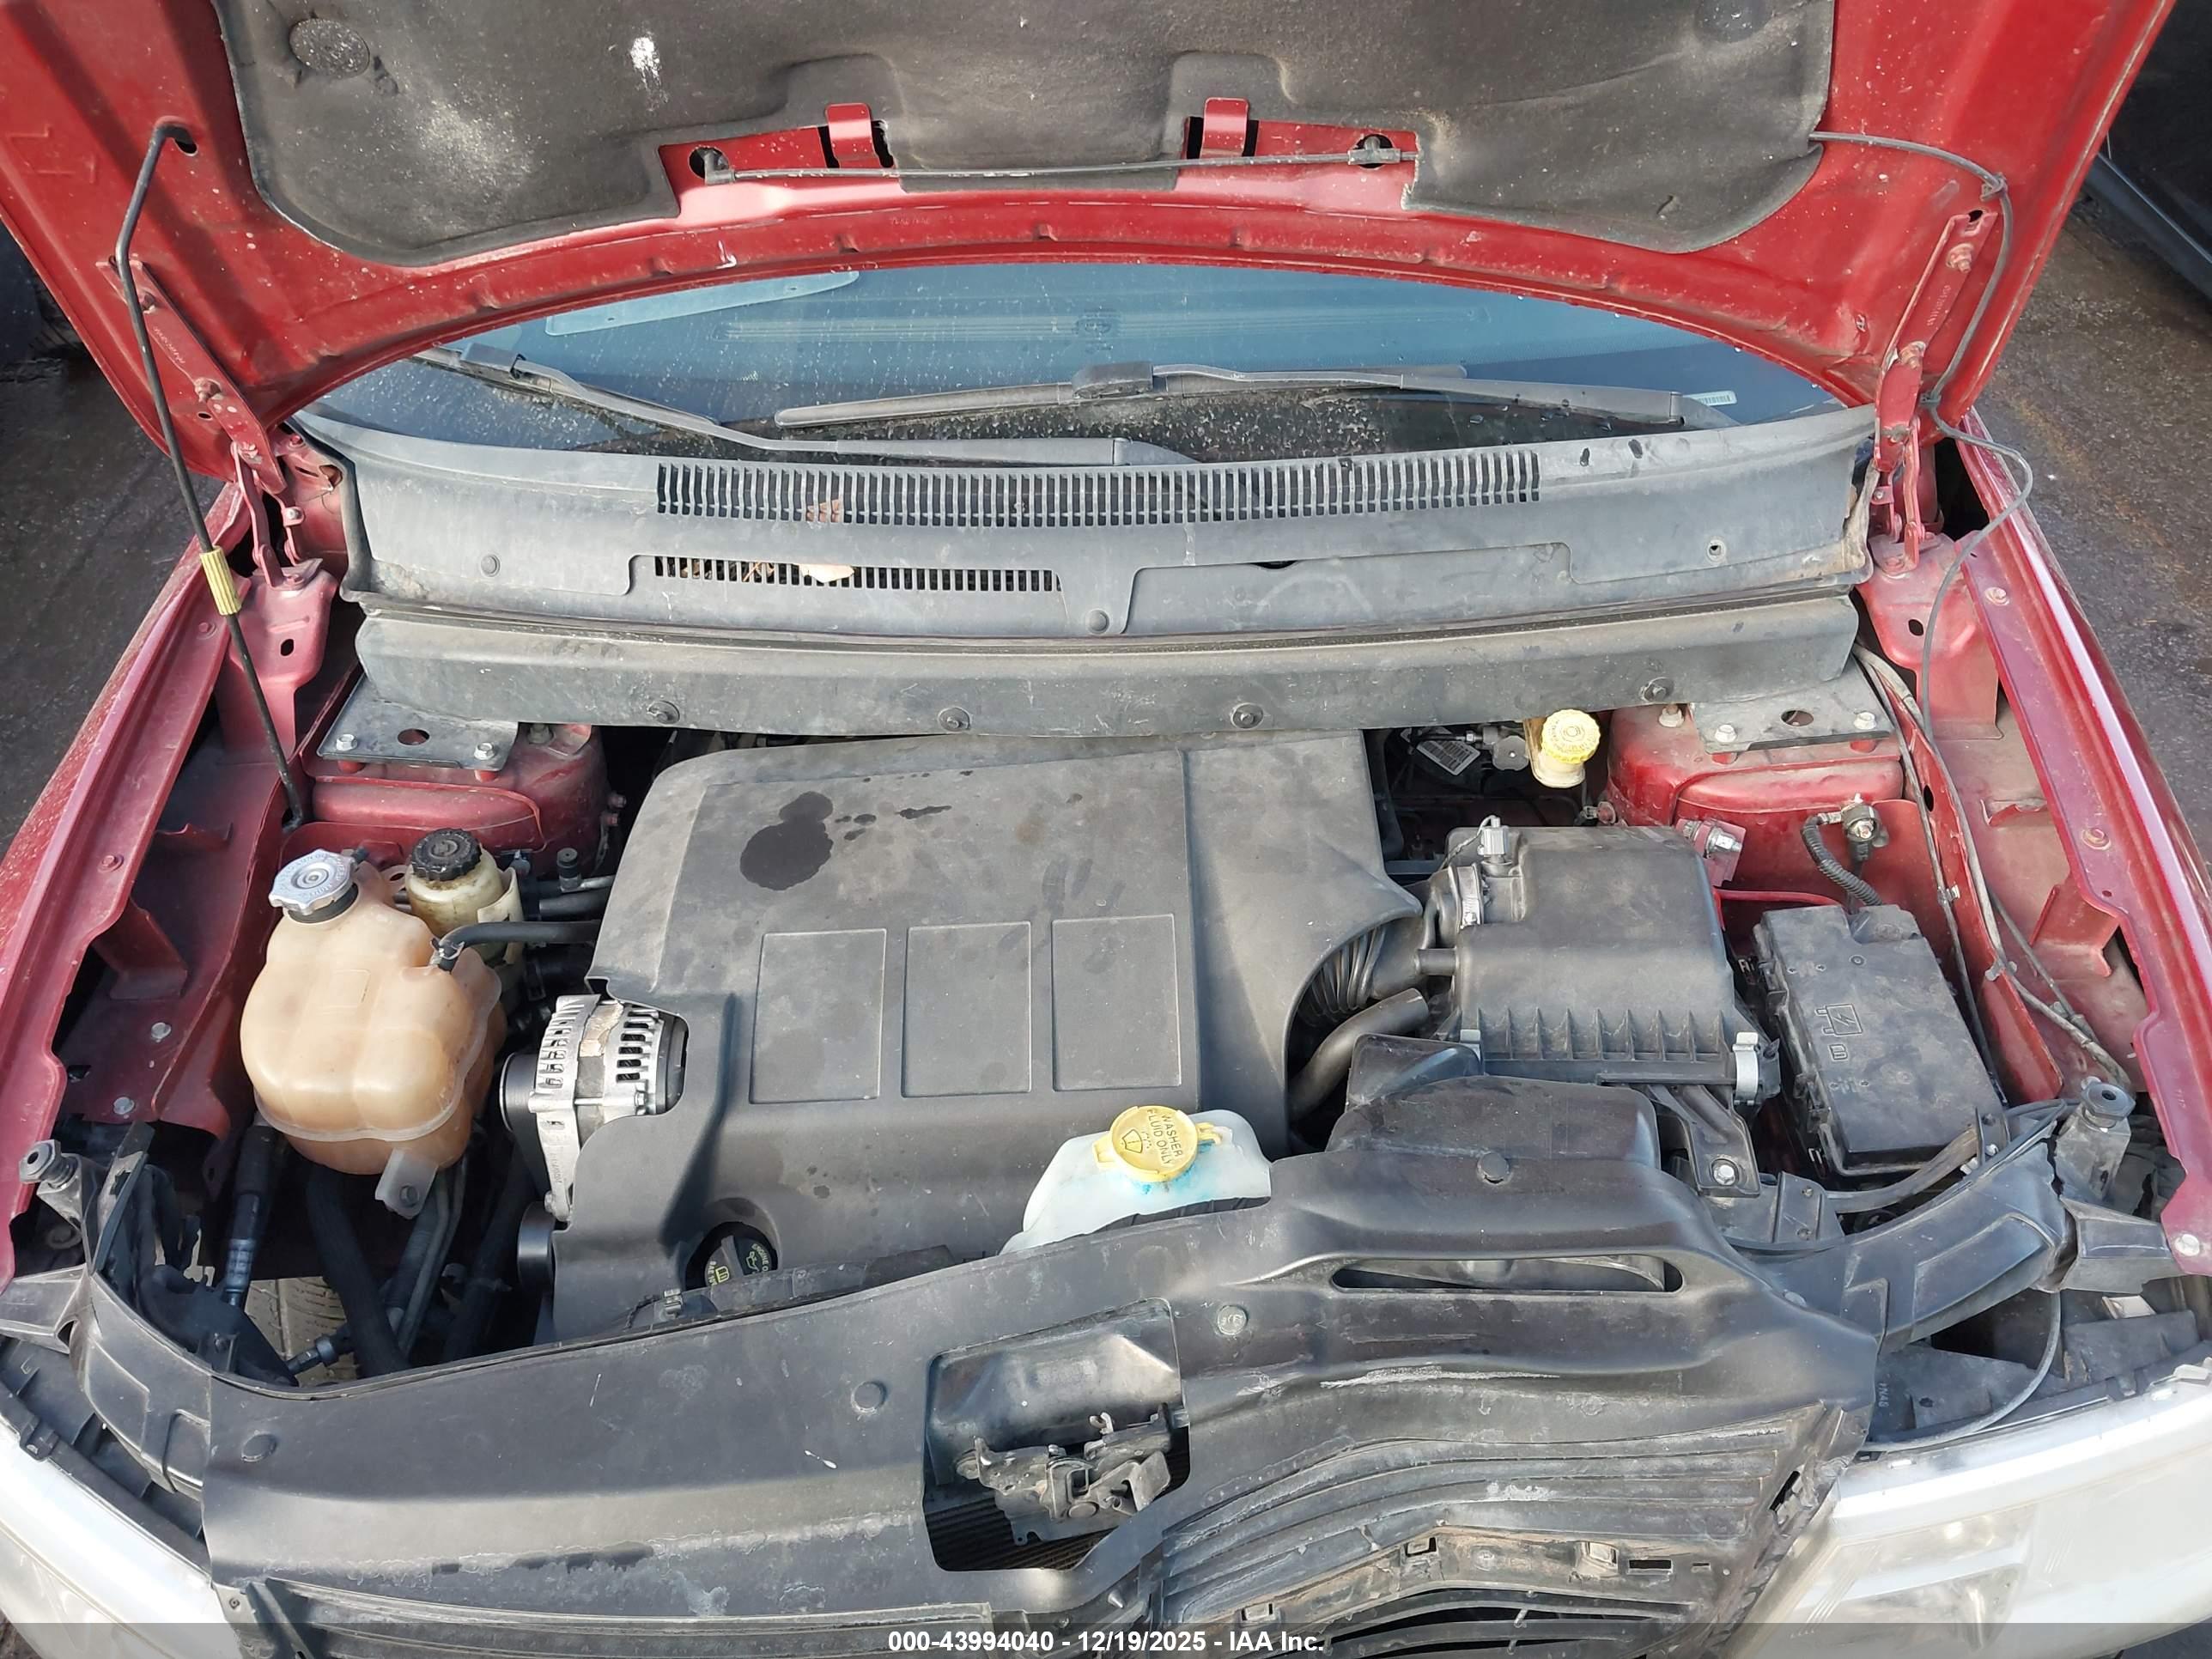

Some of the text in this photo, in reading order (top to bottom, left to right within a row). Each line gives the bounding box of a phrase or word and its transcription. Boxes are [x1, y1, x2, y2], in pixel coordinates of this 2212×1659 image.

[1147, 1109, 1175, 1164] FLUID ONLY
[1161, 1114, 1183, 1157] WASHER
[751, 1243, 769, 1265] ENGINE
